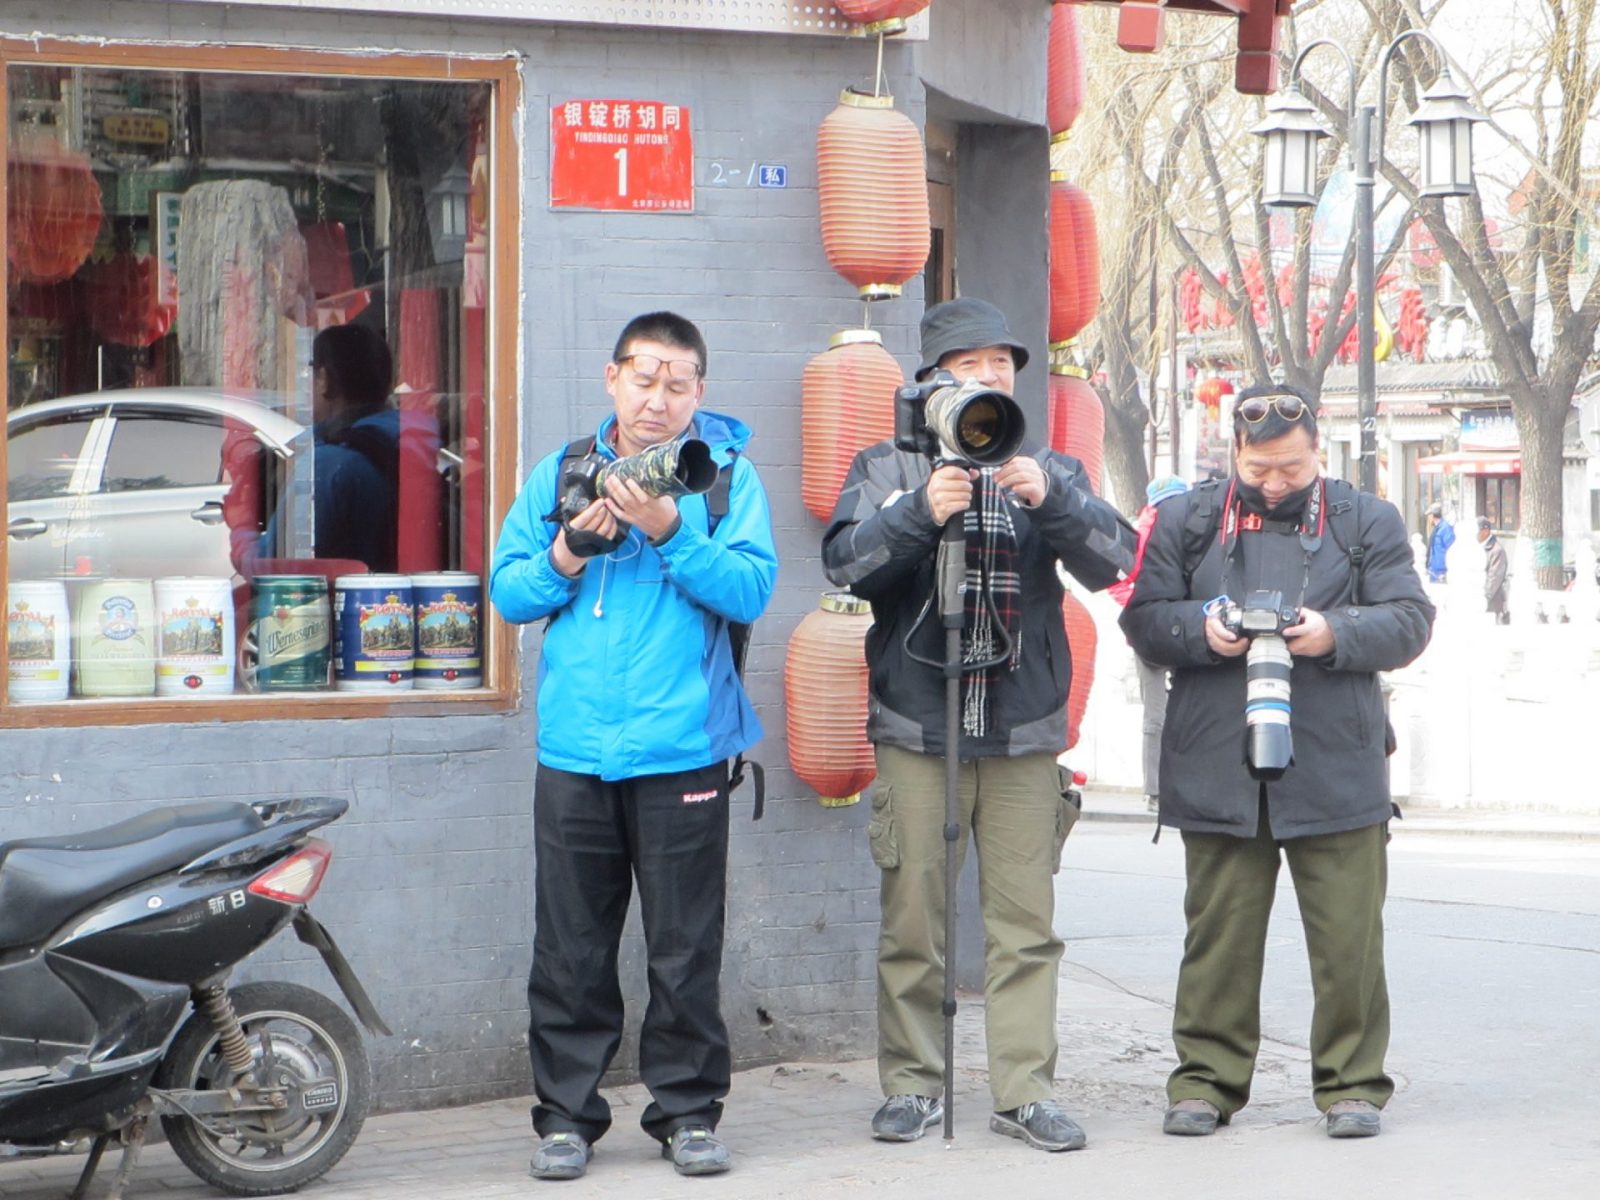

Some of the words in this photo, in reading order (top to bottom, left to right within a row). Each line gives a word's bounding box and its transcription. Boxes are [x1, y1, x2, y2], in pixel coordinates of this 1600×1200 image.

[564, 101, 681, 130] 银锭桥胡同
[574, 131, 629, 144] YINDINGQIAO
[613, 148, 628, 196] 1
[683, 790, 718, 803] Kappa
[207, 889, 246, 915] 新日
